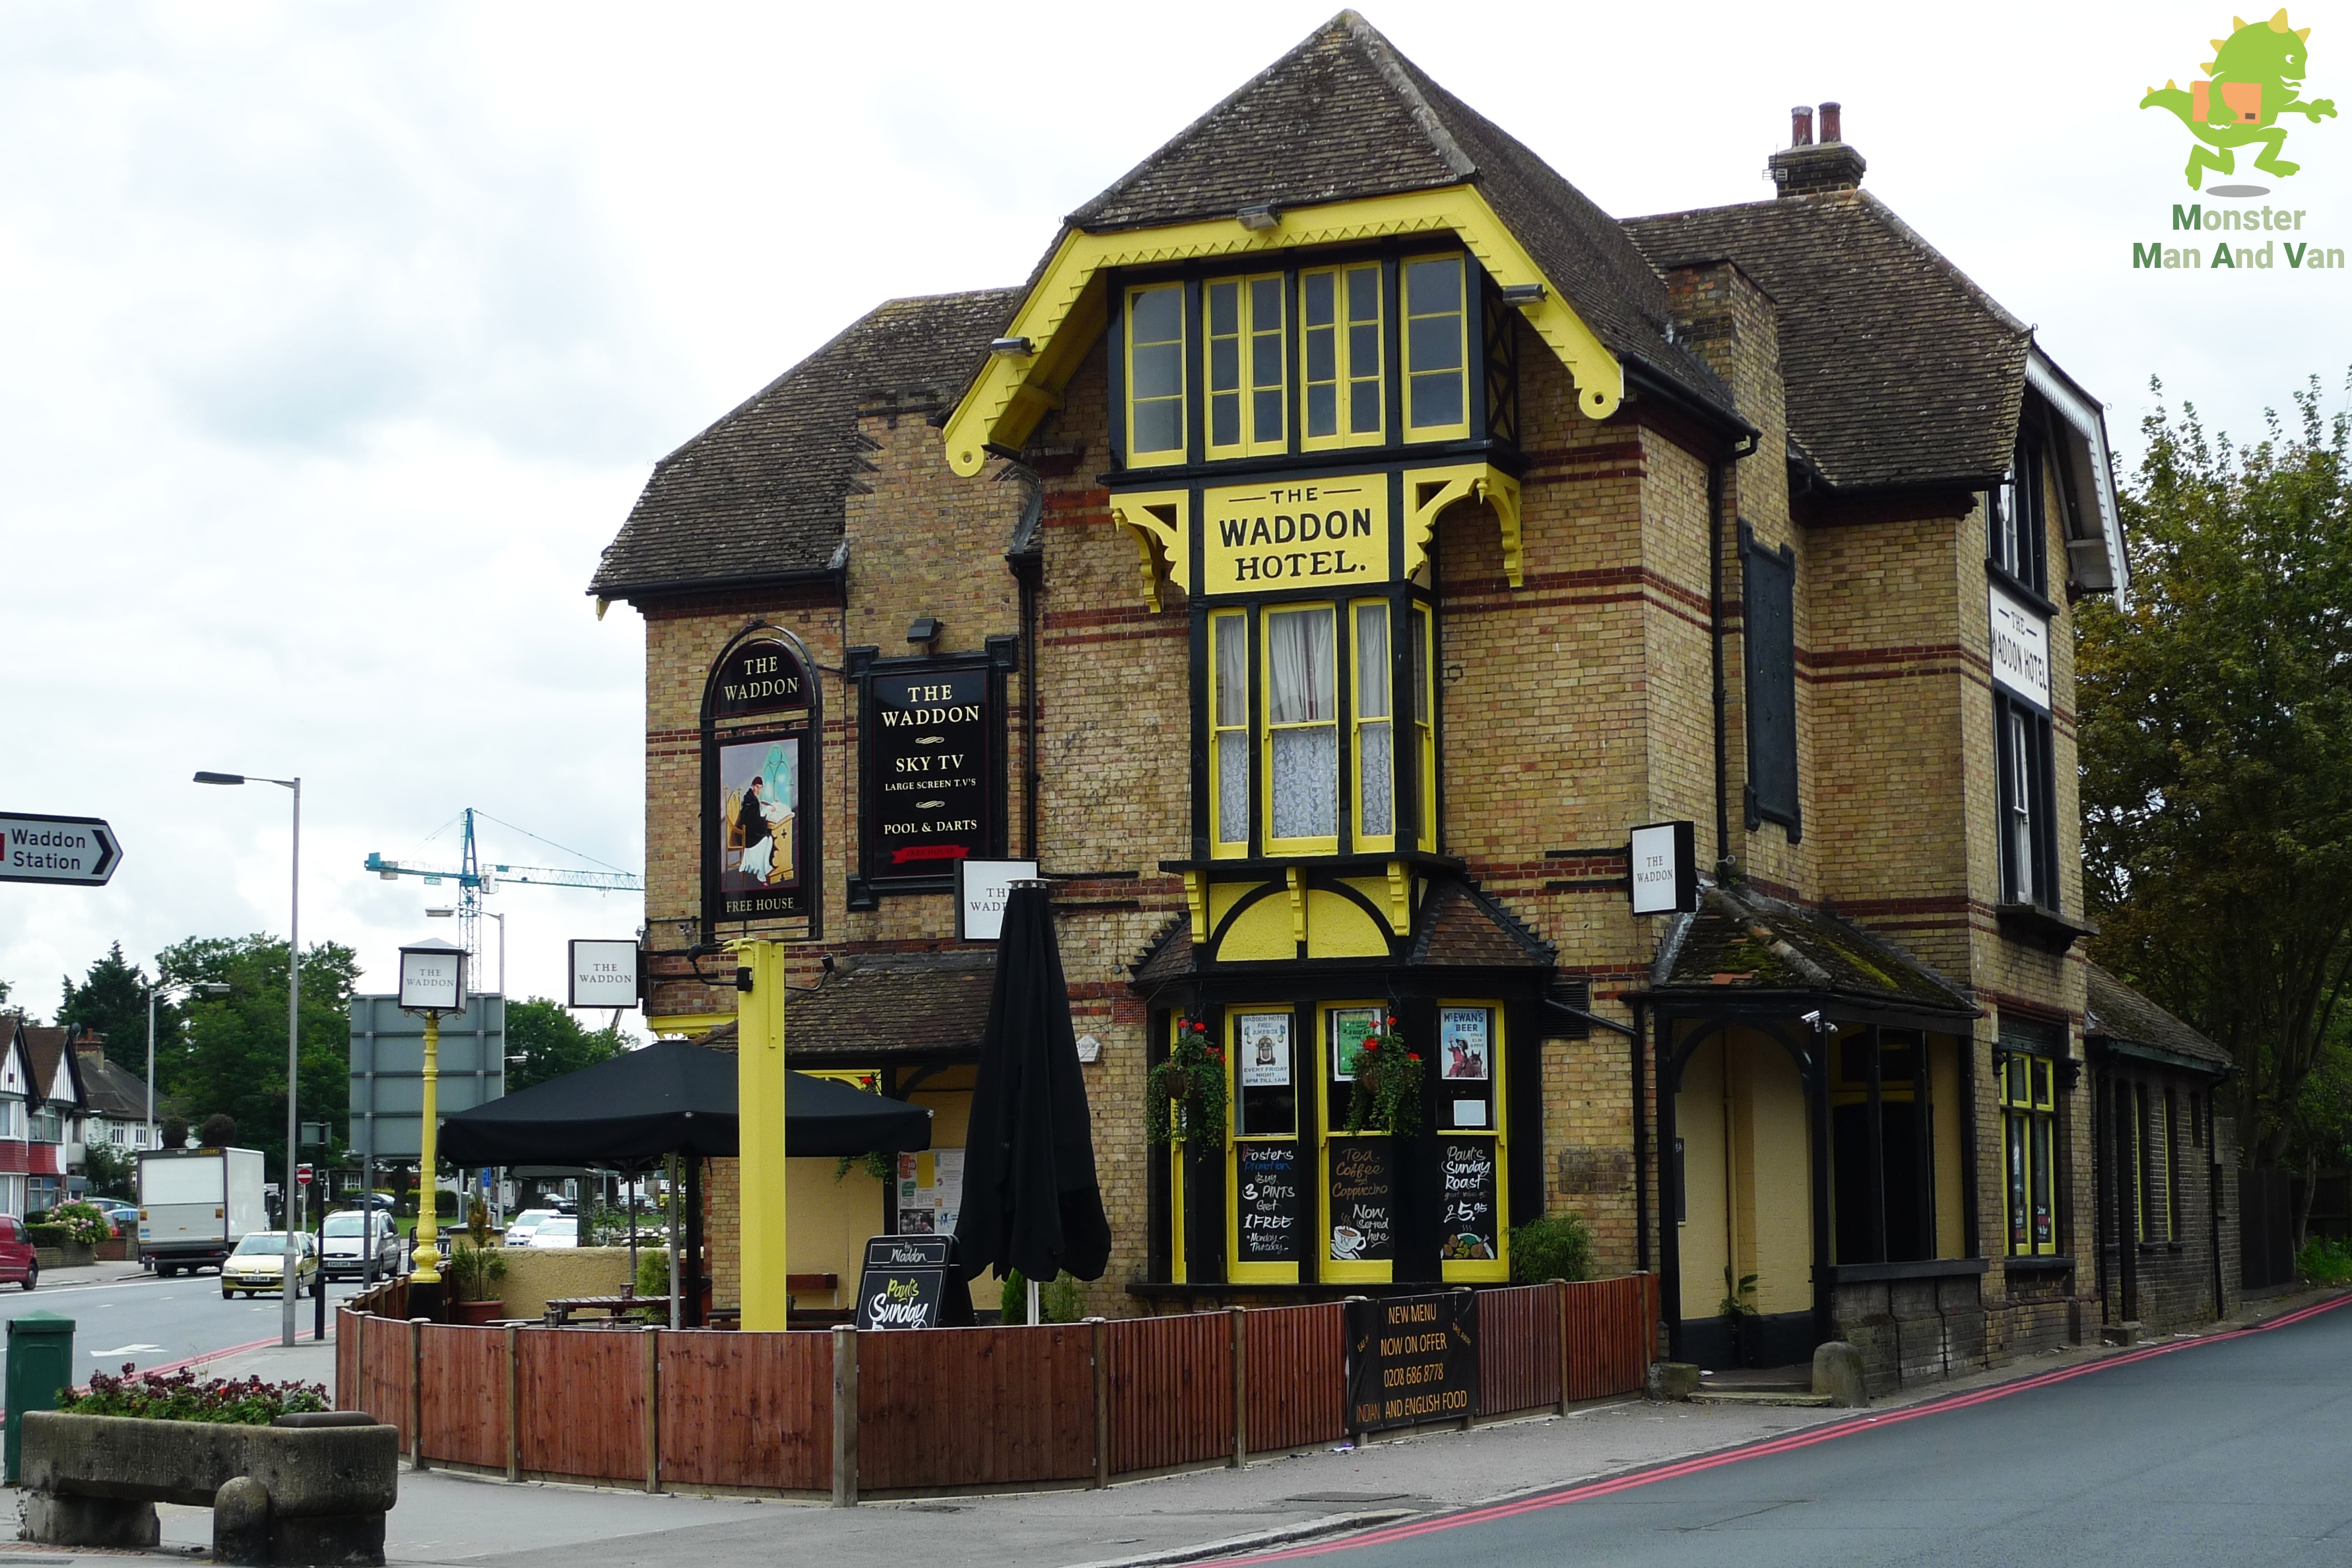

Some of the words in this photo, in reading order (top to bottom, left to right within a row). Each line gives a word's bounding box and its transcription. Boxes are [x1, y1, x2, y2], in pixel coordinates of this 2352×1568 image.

[1270, 487, 1318, 504] THE
[1219, 507, 1371, 548] WADDON
[1235, 550, 1366, 581] HOTEL.
[2011, 610, 2025, 636] THE
[744, 656, 778, 675] THE
[2024, 648, 2047, 690] HOTEL
[724, 677, 799, 702] WADDON
[907, 684, 952, 702] THE
[881, 705, 979, 727] WADDON
[896, 756, 931, 772] SKY
[938, 754, 964, 769] TV
[885, 782, 915, 791] LARGE
[916, 779, 951, 789] SCREEN
[884, 824, 918, 835] POOL
[921, 822, 932, 832] &
[936, 820, 977, 832] DARTS
[12, 828, 86, 848] Waddon
[13, 851, 81, 870] Station
[1647, 855, 1664, 867] THE
[1637, 869, 1673, 883] WADDON
[986, 888, 1012, 898] TH
[727, 900, 752, 913] FREE
[756, 898, 794, 911] HOUSE
[420, 968, 441, 977] THE
[593, 964, 618, 972] THE
[406, 978, 455, 987] WADDON
[579, 974, 632, 983] WADDON
[1242, 1144, 1294, 1161] Fosters
[1336, 1161, 1384, 1178] Coffee
[1441, 1160, 1492, 1177] Sunday
[1255, 1171, 1278, 1185] Buy
[1445, 1174, 1489, 1191] Roast
[1242, 1183, 1258, 1200] 3
[1262, 1185, 1295, 1198] PINTS
[1332, 1182, 1388, 1200] Cappuccino
[1257, 1199, 1282, 1212] Get
[1243, 1214, 1253, 1229] 1
[1253, 1214, 1294, 1229] FREE
[890, 1248, 927, 1262] Waddon
[868, 1293, 929, 1328] Sunday
[1388, 1305, 1408, 1324] NEW
[1411, 1303, 1437, 1323] MENU
[1381, 1336, 1403, 1356] NOW
[1404, 1334, 1418, 1354] ON
[1420, 1332, 1447, 1352] OFFER
[1384, 1367, 1404, 1387] 0208
[1406, 1365, 1421, 1385] 686
[1423, 1363, 1443, 1382] 8778
[1356, 1402, 1380, 1423] INDIAN
[1386, 1399, 1403, 1418] AND
[1405, 1393, 1440, 1416] ENGLISH
[1443, 1390, 1467, 1410] FOOD
